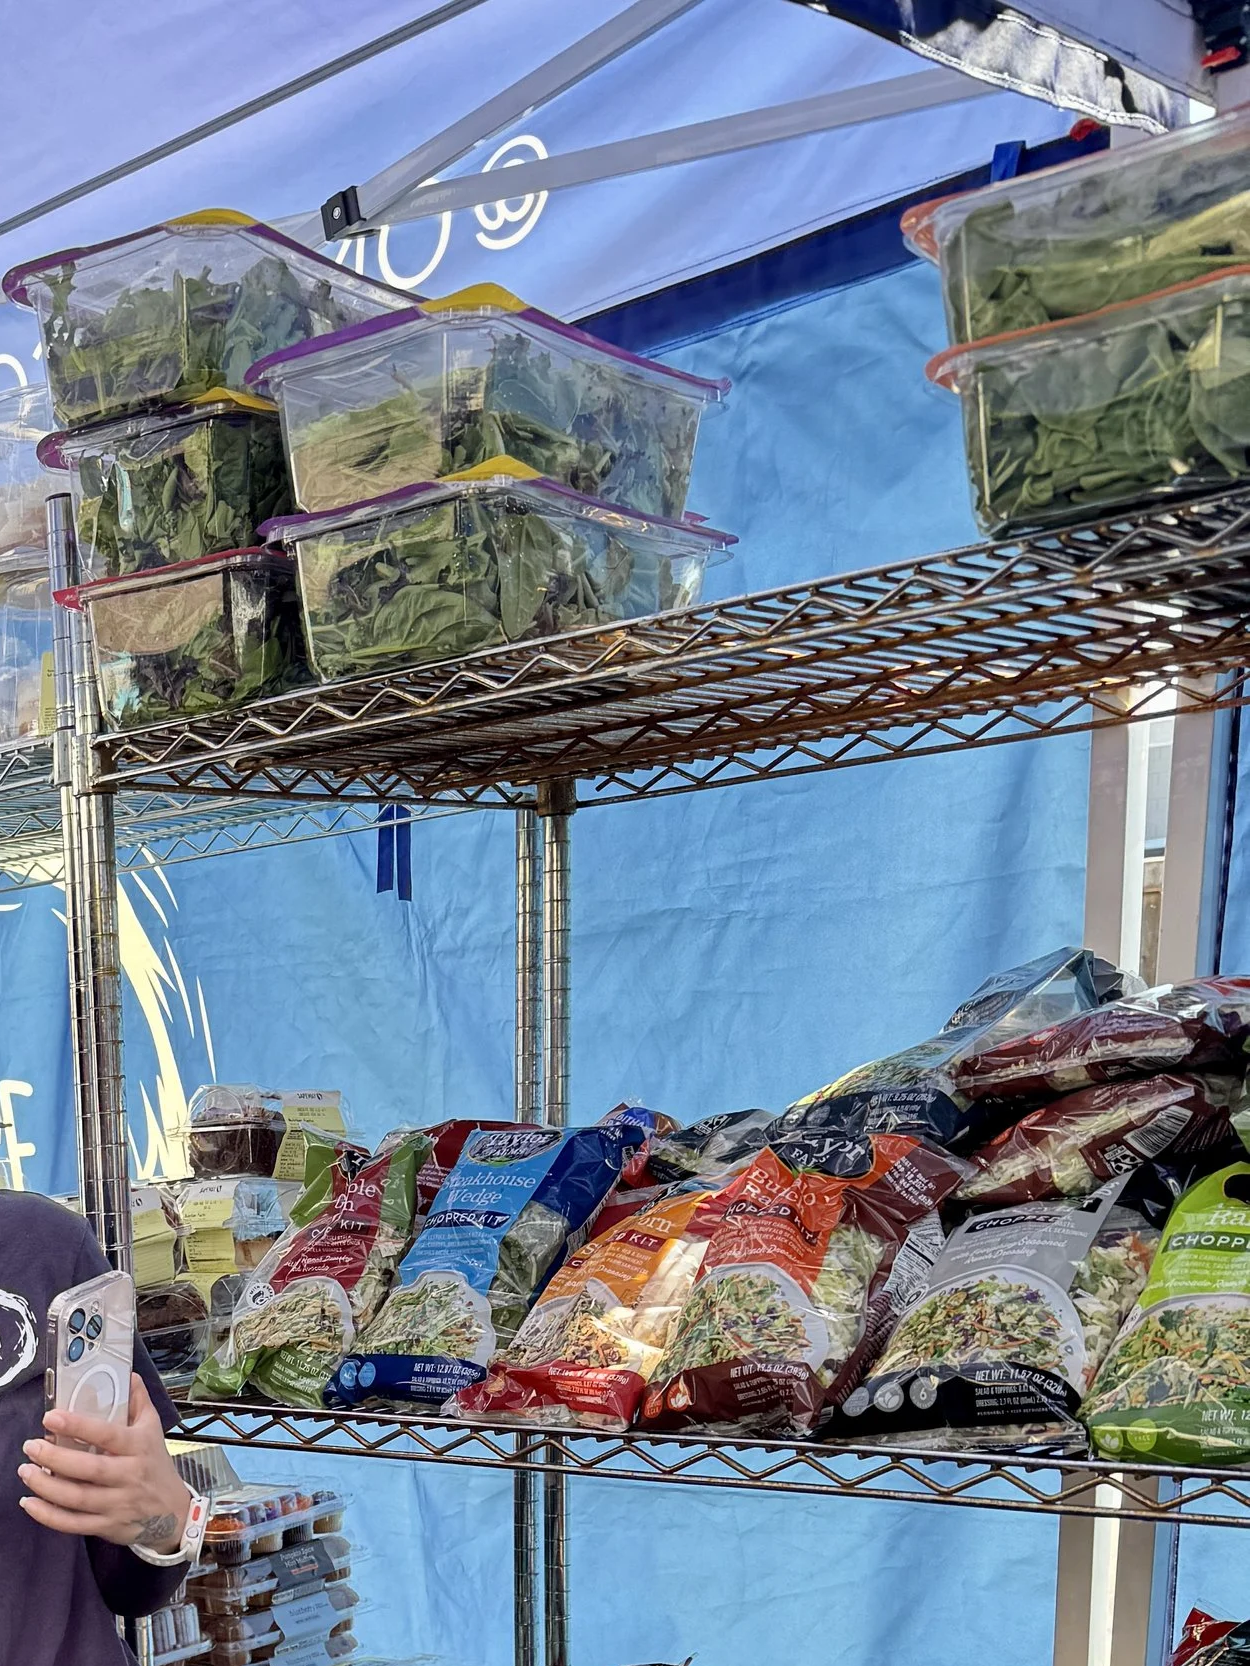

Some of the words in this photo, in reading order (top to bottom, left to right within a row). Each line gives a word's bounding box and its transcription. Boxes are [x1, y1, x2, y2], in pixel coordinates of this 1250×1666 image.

[486, 1132, 554, 1147] Taylor
[441, 1171, 537, 1191] Steakhouse
[447, 1188, 503, 1206] Wedge
[340, 1219, 365, 1231] KIT
[424, 1211, 477, 1228] CHOPPED
[479, 1214, 506, 1226] KIT
[629, 1232, 659, 1248] KIT
[413, 1362, 425, 1373] NET
[730, 1367, 743, 1378] NET
[773, 1364, 784, 1374] OZ
[975, 1369, 990, 1382] NET
[919, 1388, 927, 1401] 6
[1201, 1410, 1217, 1422] NET
